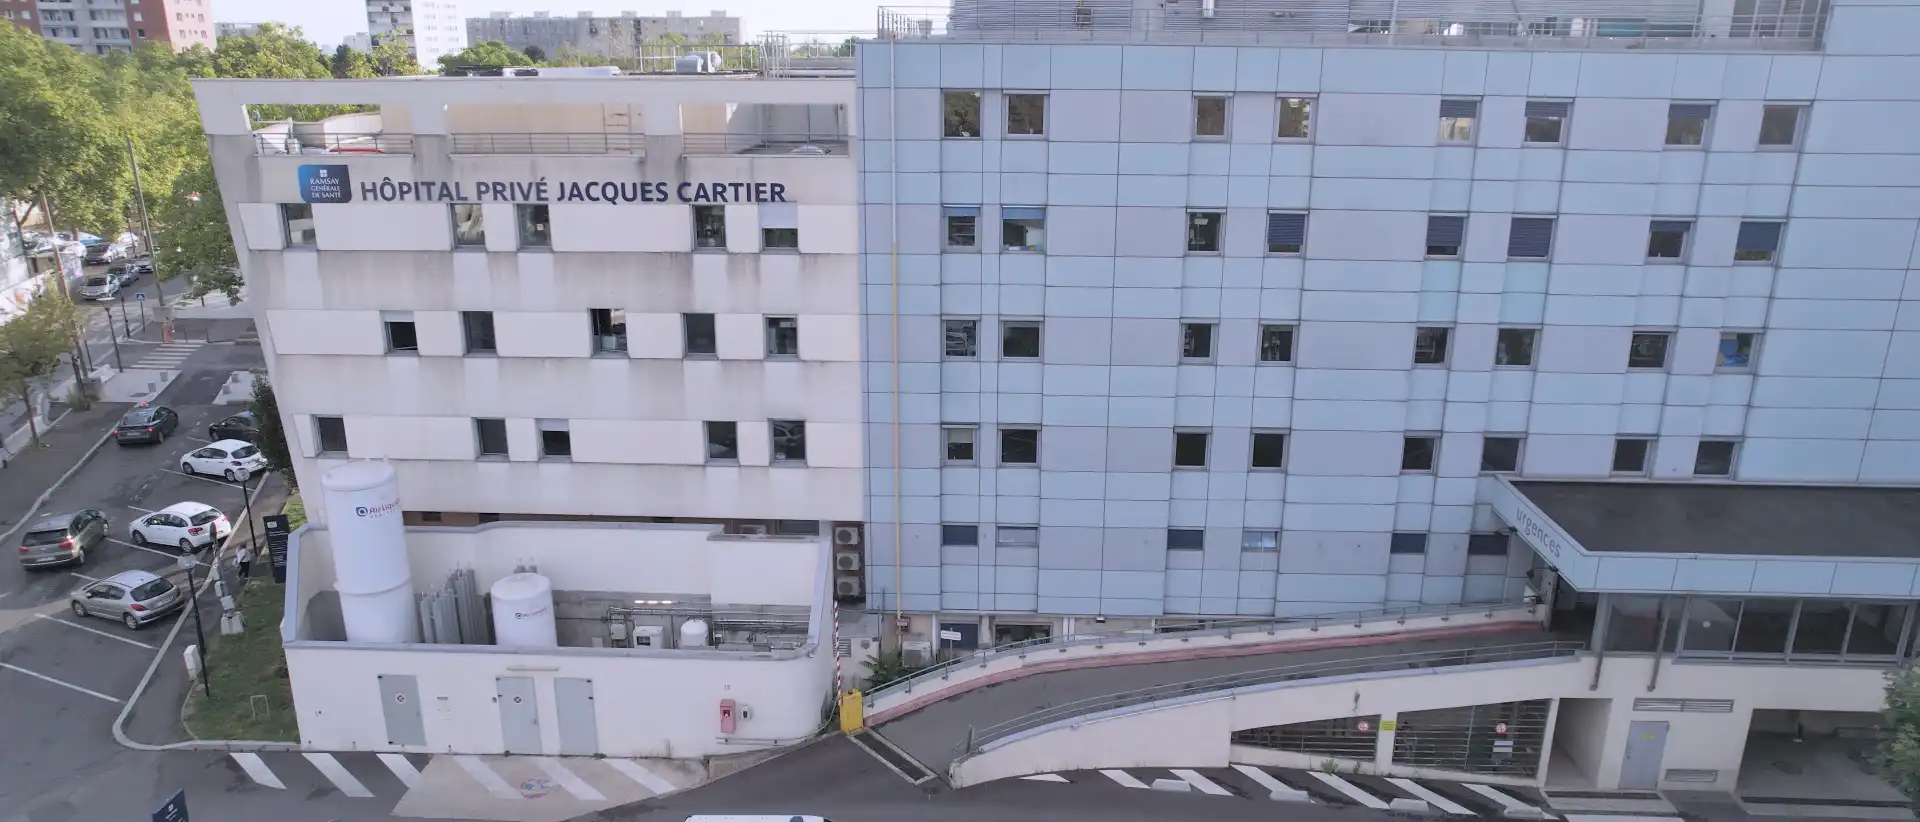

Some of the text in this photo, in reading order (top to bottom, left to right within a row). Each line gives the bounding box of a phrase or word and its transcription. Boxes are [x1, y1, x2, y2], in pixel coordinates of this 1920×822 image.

[360, 177, 786, 204] HÔPITAL PRIVÉ JACQUES CARTIER
[1516, 506, 1561, 558] urgences
